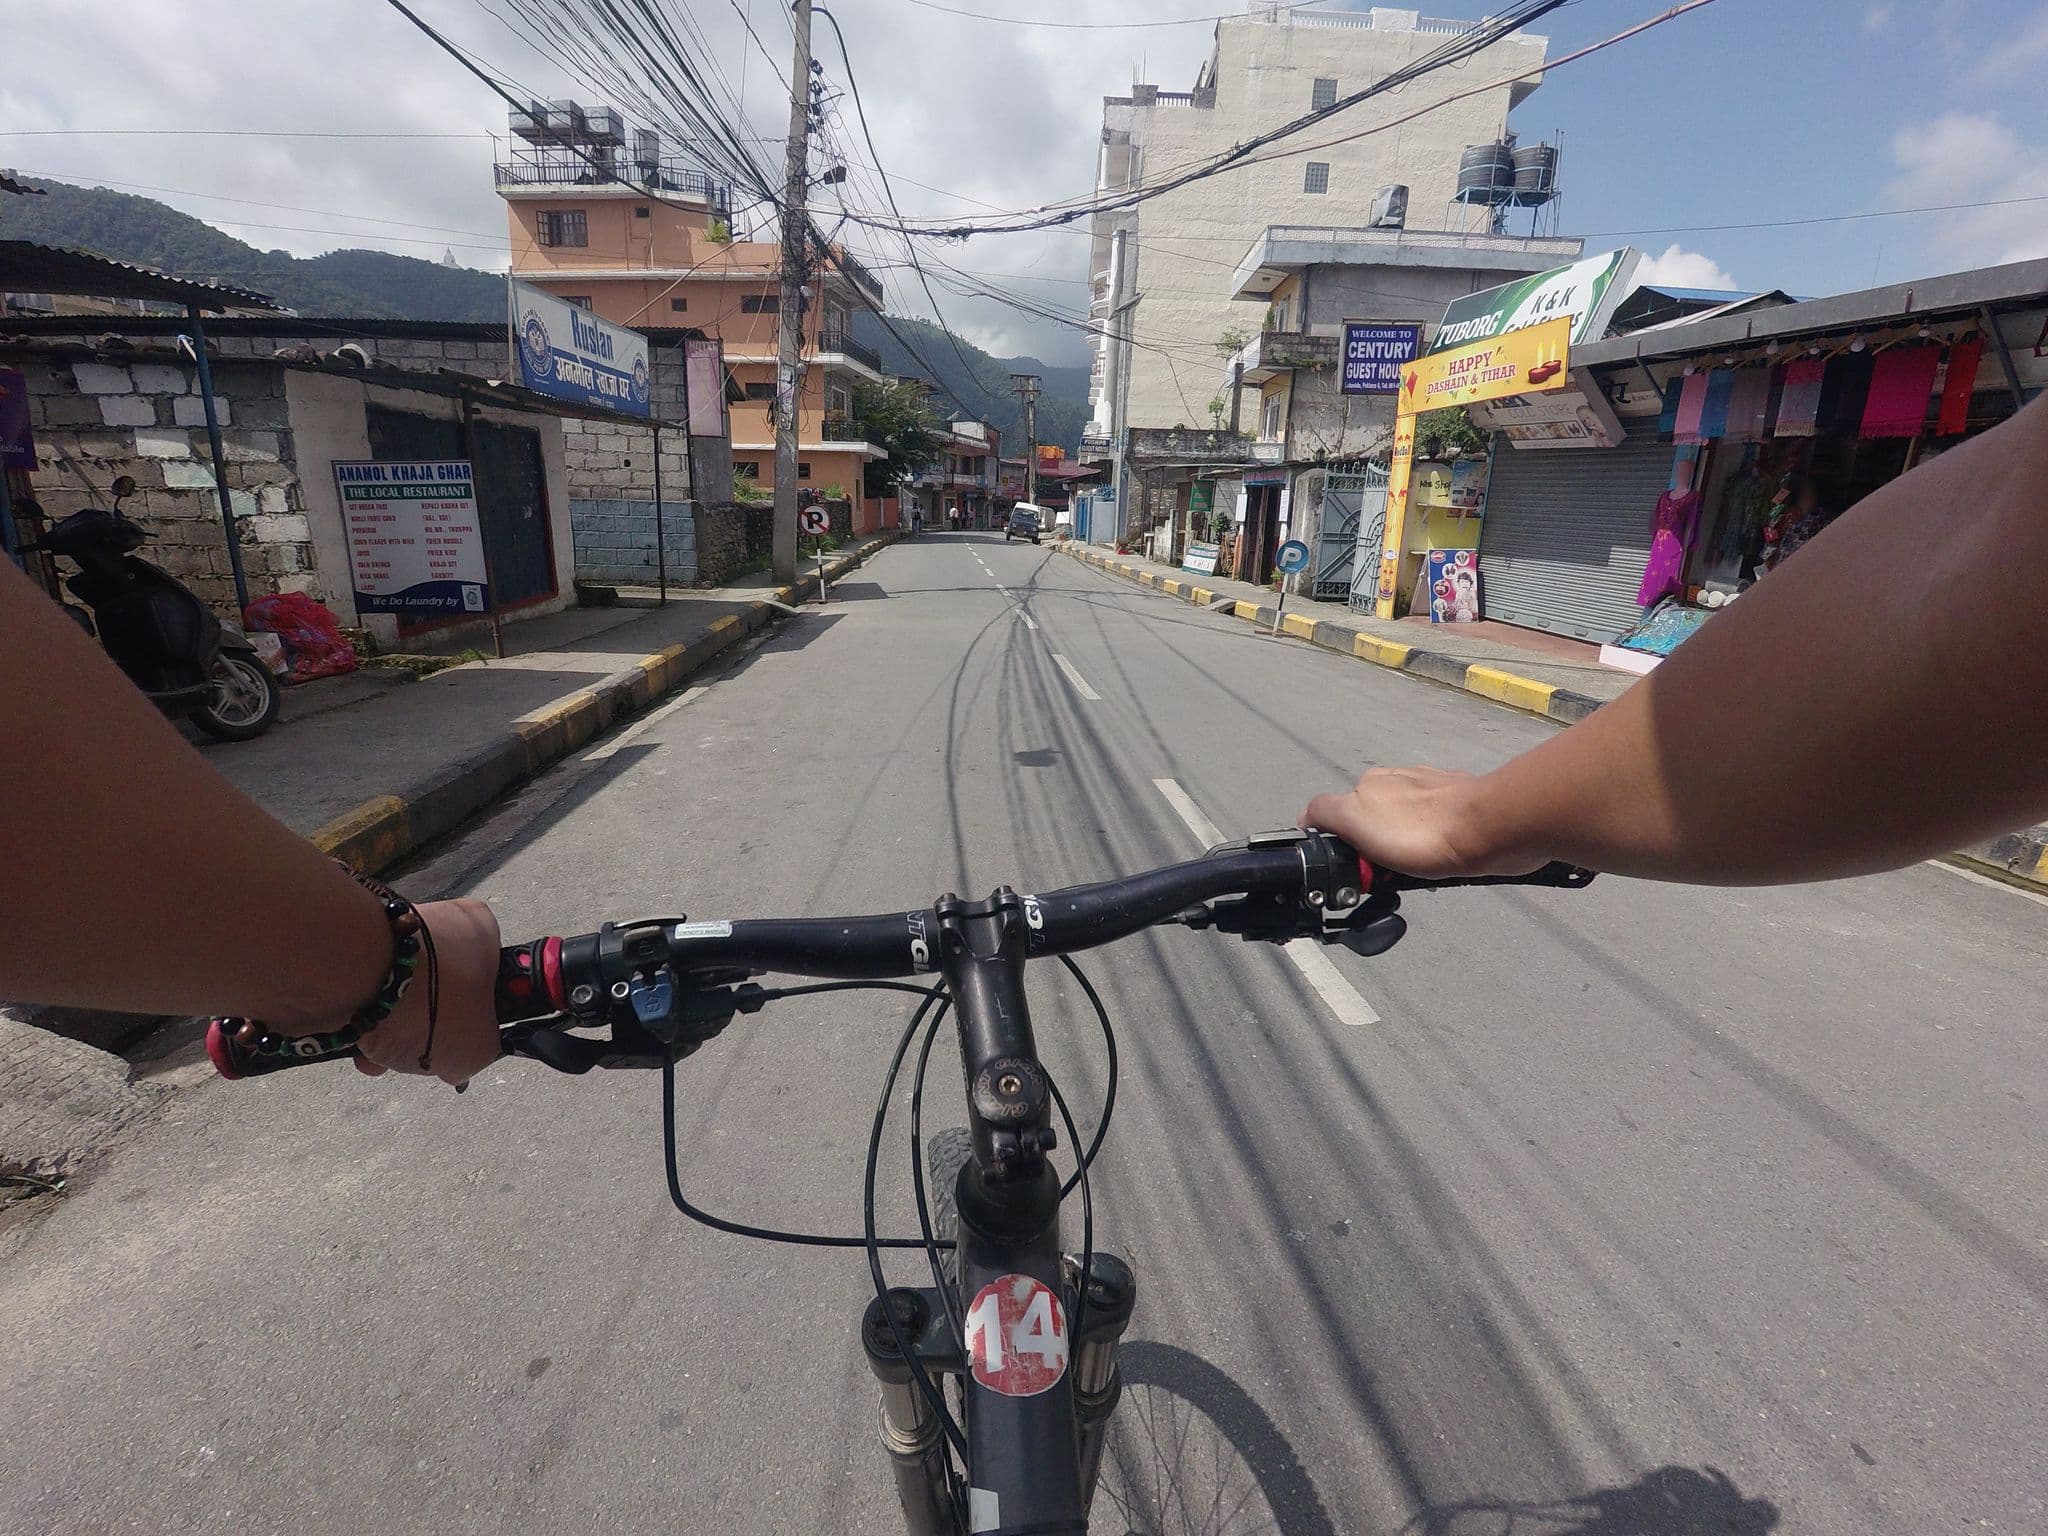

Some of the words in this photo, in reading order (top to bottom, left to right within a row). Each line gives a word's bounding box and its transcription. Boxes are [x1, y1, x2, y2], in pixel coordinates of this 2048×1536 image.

[1530, 292, 1546, 315] K
[1545, 293, 1559, 312] &
[1558, 285, 1577, 308] K
[571, 308, 615, 362] Ruslan
[1352, 330, 1396, 338] WELCOME
[1434, 310, 1504, 349] TUBORG
[1348, 341, 1413, 359] CENTURY
[1346, 362, 1377, 379] GUEST
[1379, 363, 1403, 379] HOUS
[1448, 351, 1493, 376] HAPPY
[553, 355, 595, 391] अनमोल
[619, 377, 631, 401] घर
[1427, 375, 1469, 394] DASHAIN
[1470, 373, 1478, 386] &
[1481, 364, 1516, 383] TIHAR
[339, 466, 388, 482] ANAMOL
[391, 465, 434, 481] KHAJA
[437, 465, 471, 480] GHAR
[348, 487, 368, 498] THE
[370, 487, 400, 498] LOCAL
[403, 486, 466, 498] RESTAURANT
[807, 512, 823, 530] P
[1280, 547, 1303, 567] P
[372, 597, 387, 606] We
[389, 597, 403, 606] Do
[405, 596, 445, 608] Laundry
[445, 596, 460, 608] by
[966, 1291, 1067, 1374] 14
